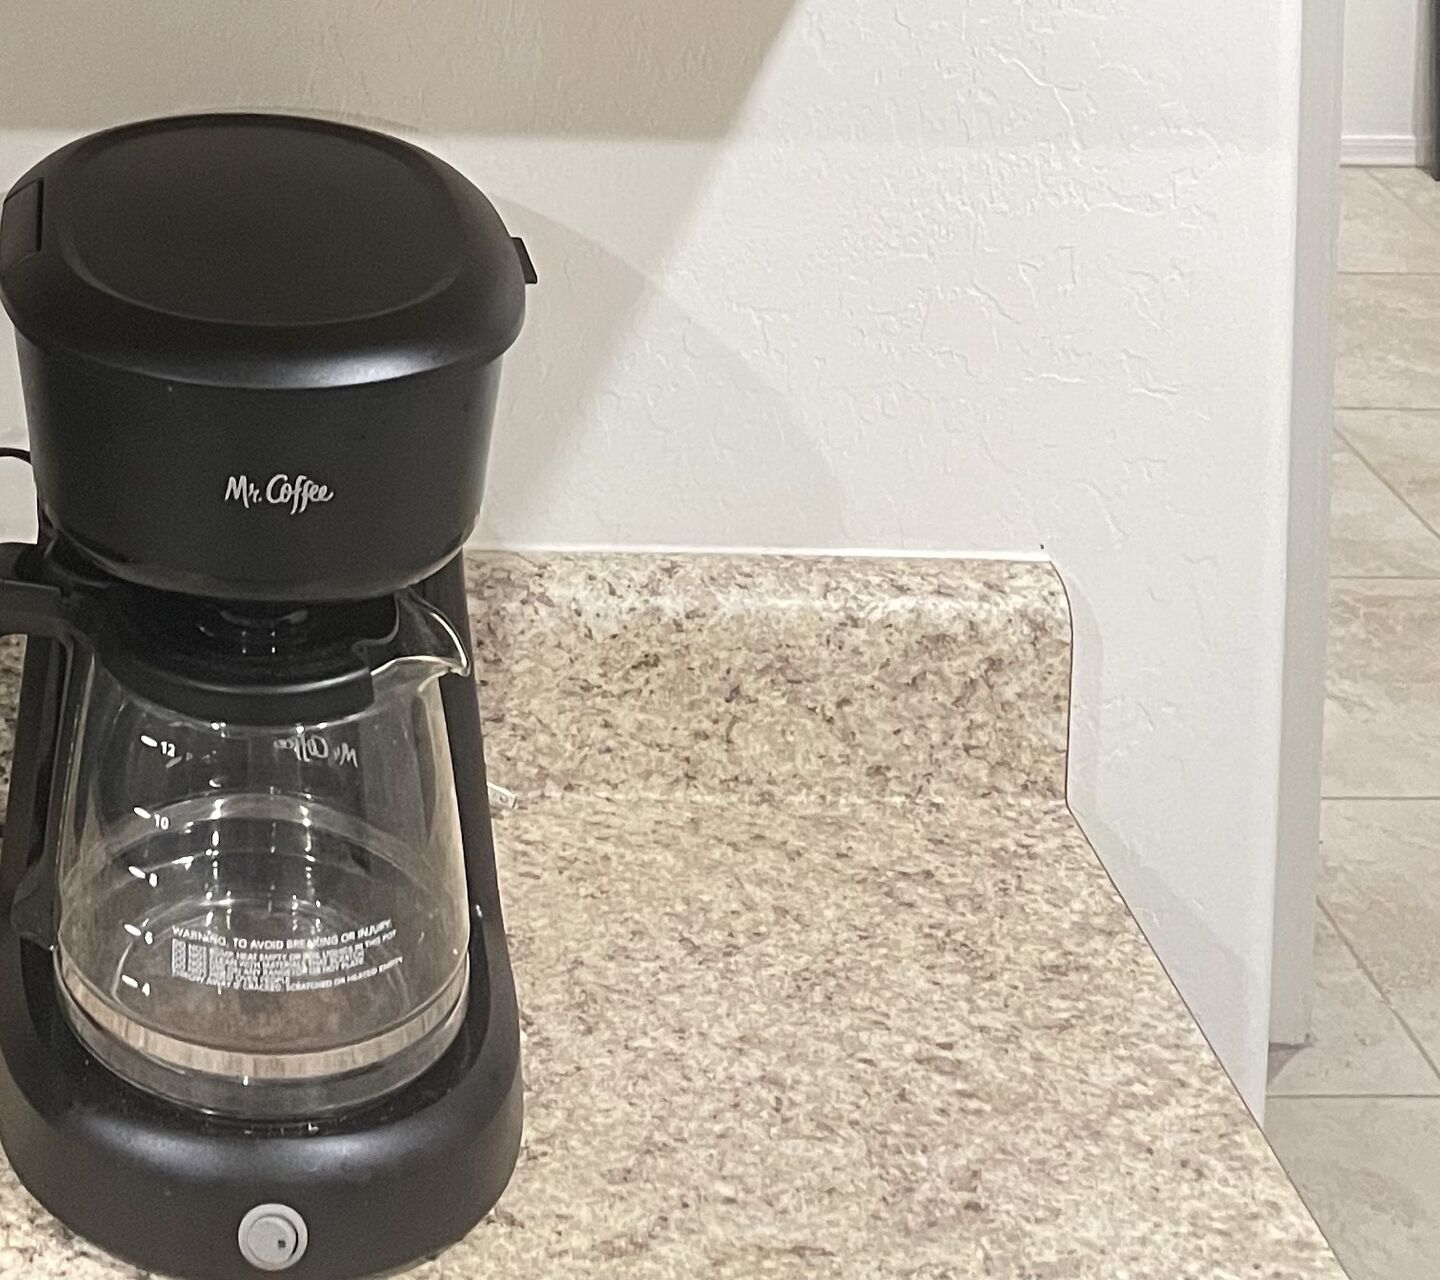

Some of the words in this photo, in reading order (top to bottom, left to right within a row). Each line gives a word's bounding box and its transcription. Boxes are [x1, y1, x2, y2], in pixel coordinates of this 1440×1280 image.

[224, 474, 262, 509] Mr.
[265, 473, 335, 516] Coffee
[160, 741, 176, 757] 12
[154, 813, 170, 830] 10
[233, 937, 247, 949] TO
[249, 939, 284, 951] AVOID
[286, 934, 339, 950] BREAKING
[340, 931, 356, 944] OR
